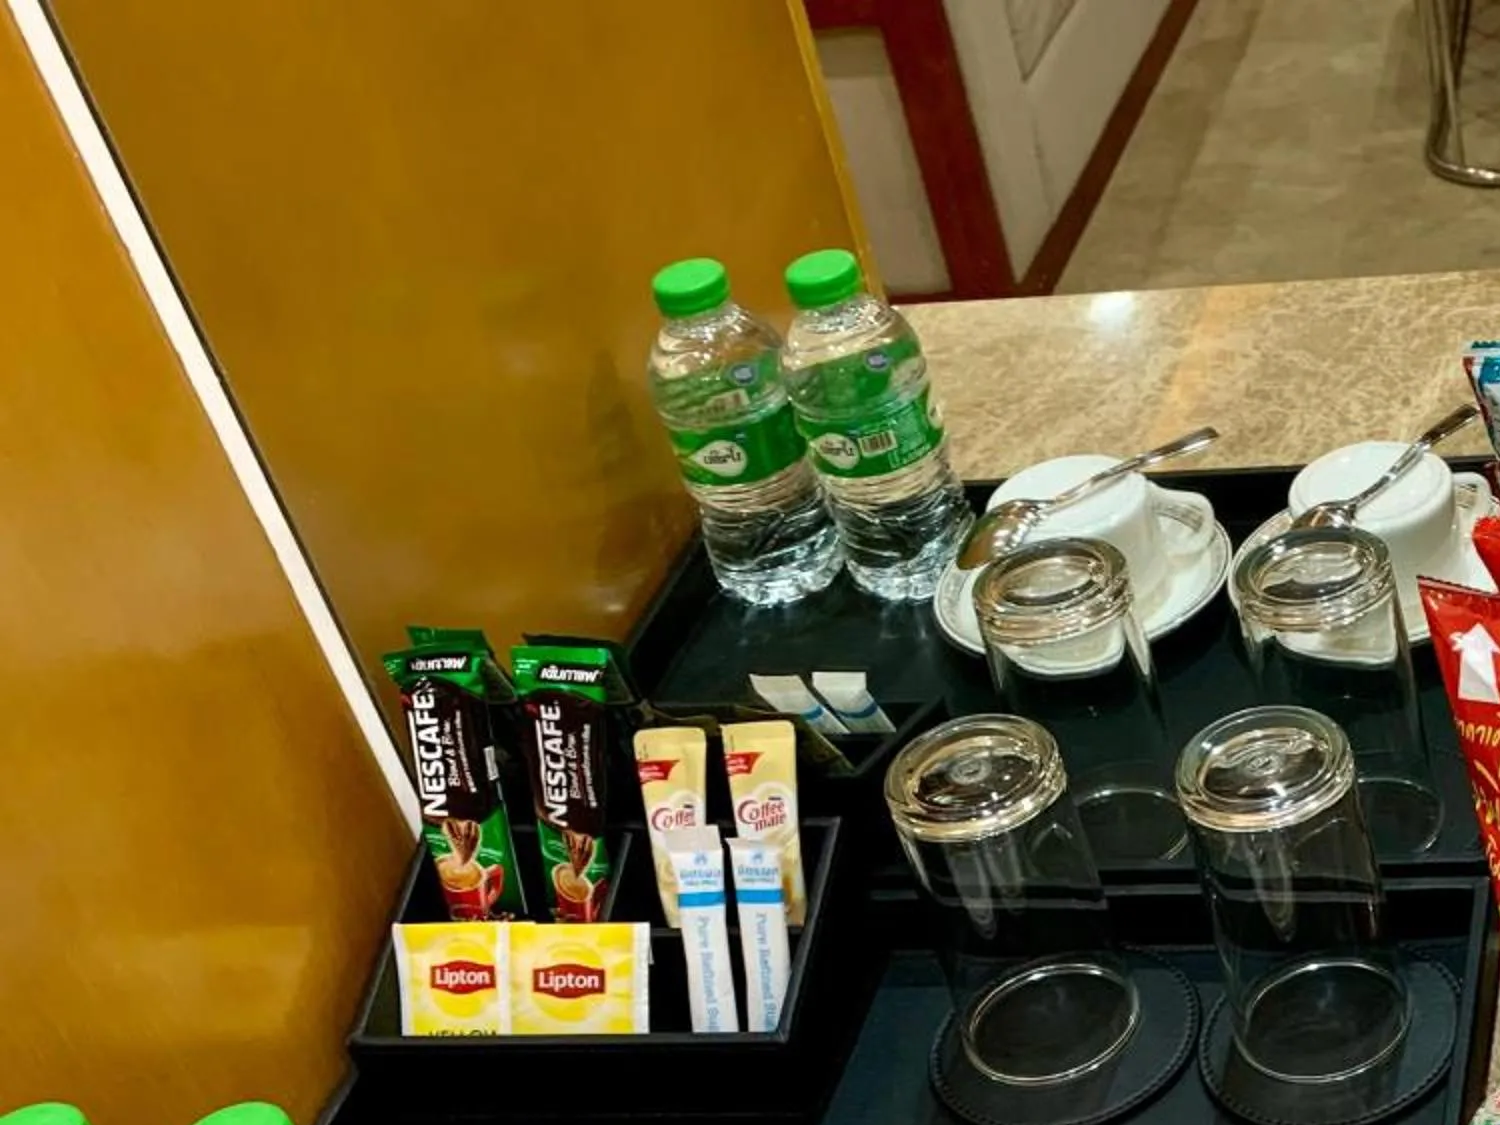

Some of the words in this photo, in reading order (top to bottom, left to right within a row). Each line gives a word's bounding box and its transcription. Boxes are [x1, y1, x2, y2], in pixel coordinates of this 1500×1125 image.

[738, 798, 785, 824] Coffee
[434, 967, 491, 987] Lipton
[539, 970, 600, 990] Lipton
